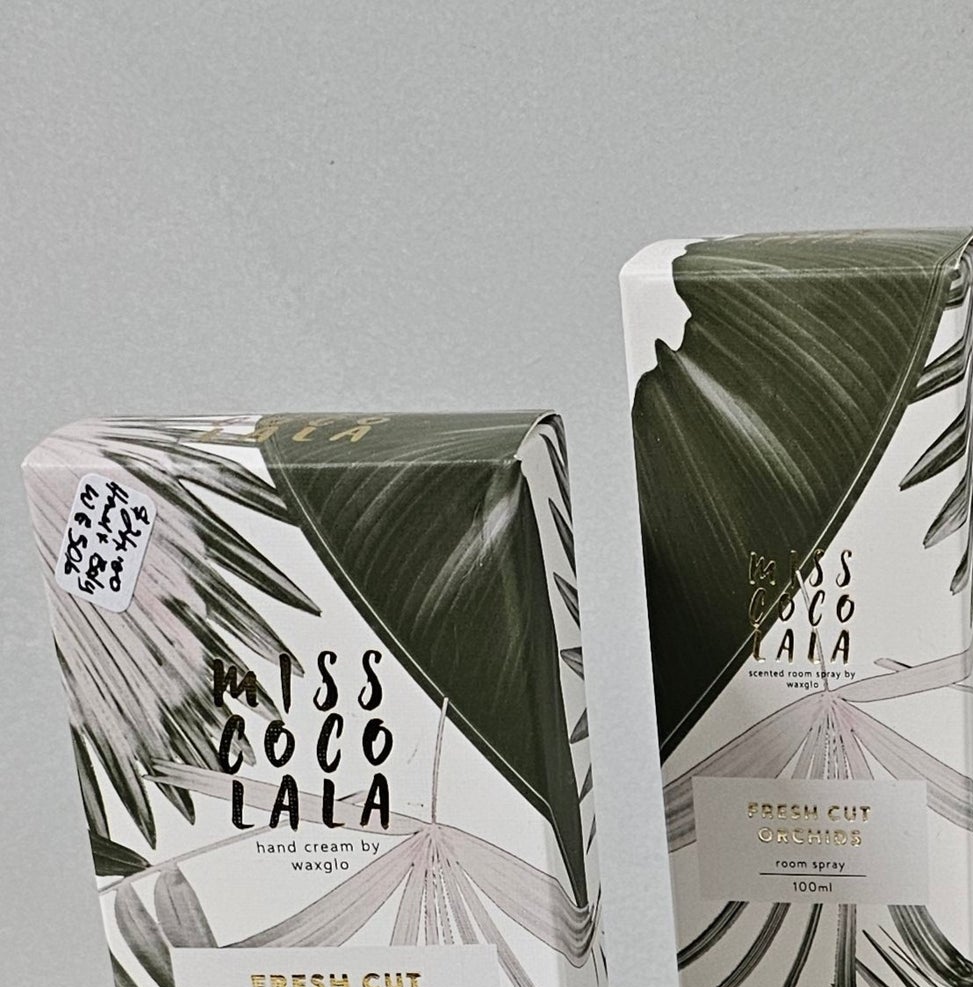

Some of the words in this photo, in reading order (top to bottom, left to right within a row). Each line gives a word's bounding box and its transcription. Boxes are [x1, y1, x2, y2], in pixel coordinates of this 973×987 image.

[749, 549, 852, 588] MISS
[750, 588, 855, 627] COCO
[752, 628, 851, 665] LALA
[213, 650, 382, 714] MISS
[749, 669, 785, 679] scented
[788, 670, 812, 678] room
[816, 670, 841, 681] spray
[844, 669, 856, 679] by
[786, 680, 819, 690] waxglo
[219, 712, 393, 775] COCO
[231, 772, 390, 832] LALA
[748, 802, 818, 820] FRESH
[827, 805, 871, 823] CUT
[256, 841, 297, 854] hand
[304, 841, 354, 853] cream
[361, 839, 380, 855] by
[758, 826, 862, 847] ORCHIDS
[291, 858, 350, 874] waxglo
[776, 860, 808, 869] room
[812, 861, 845, 872] spray
[793, 881, 832, 893] 100ml
